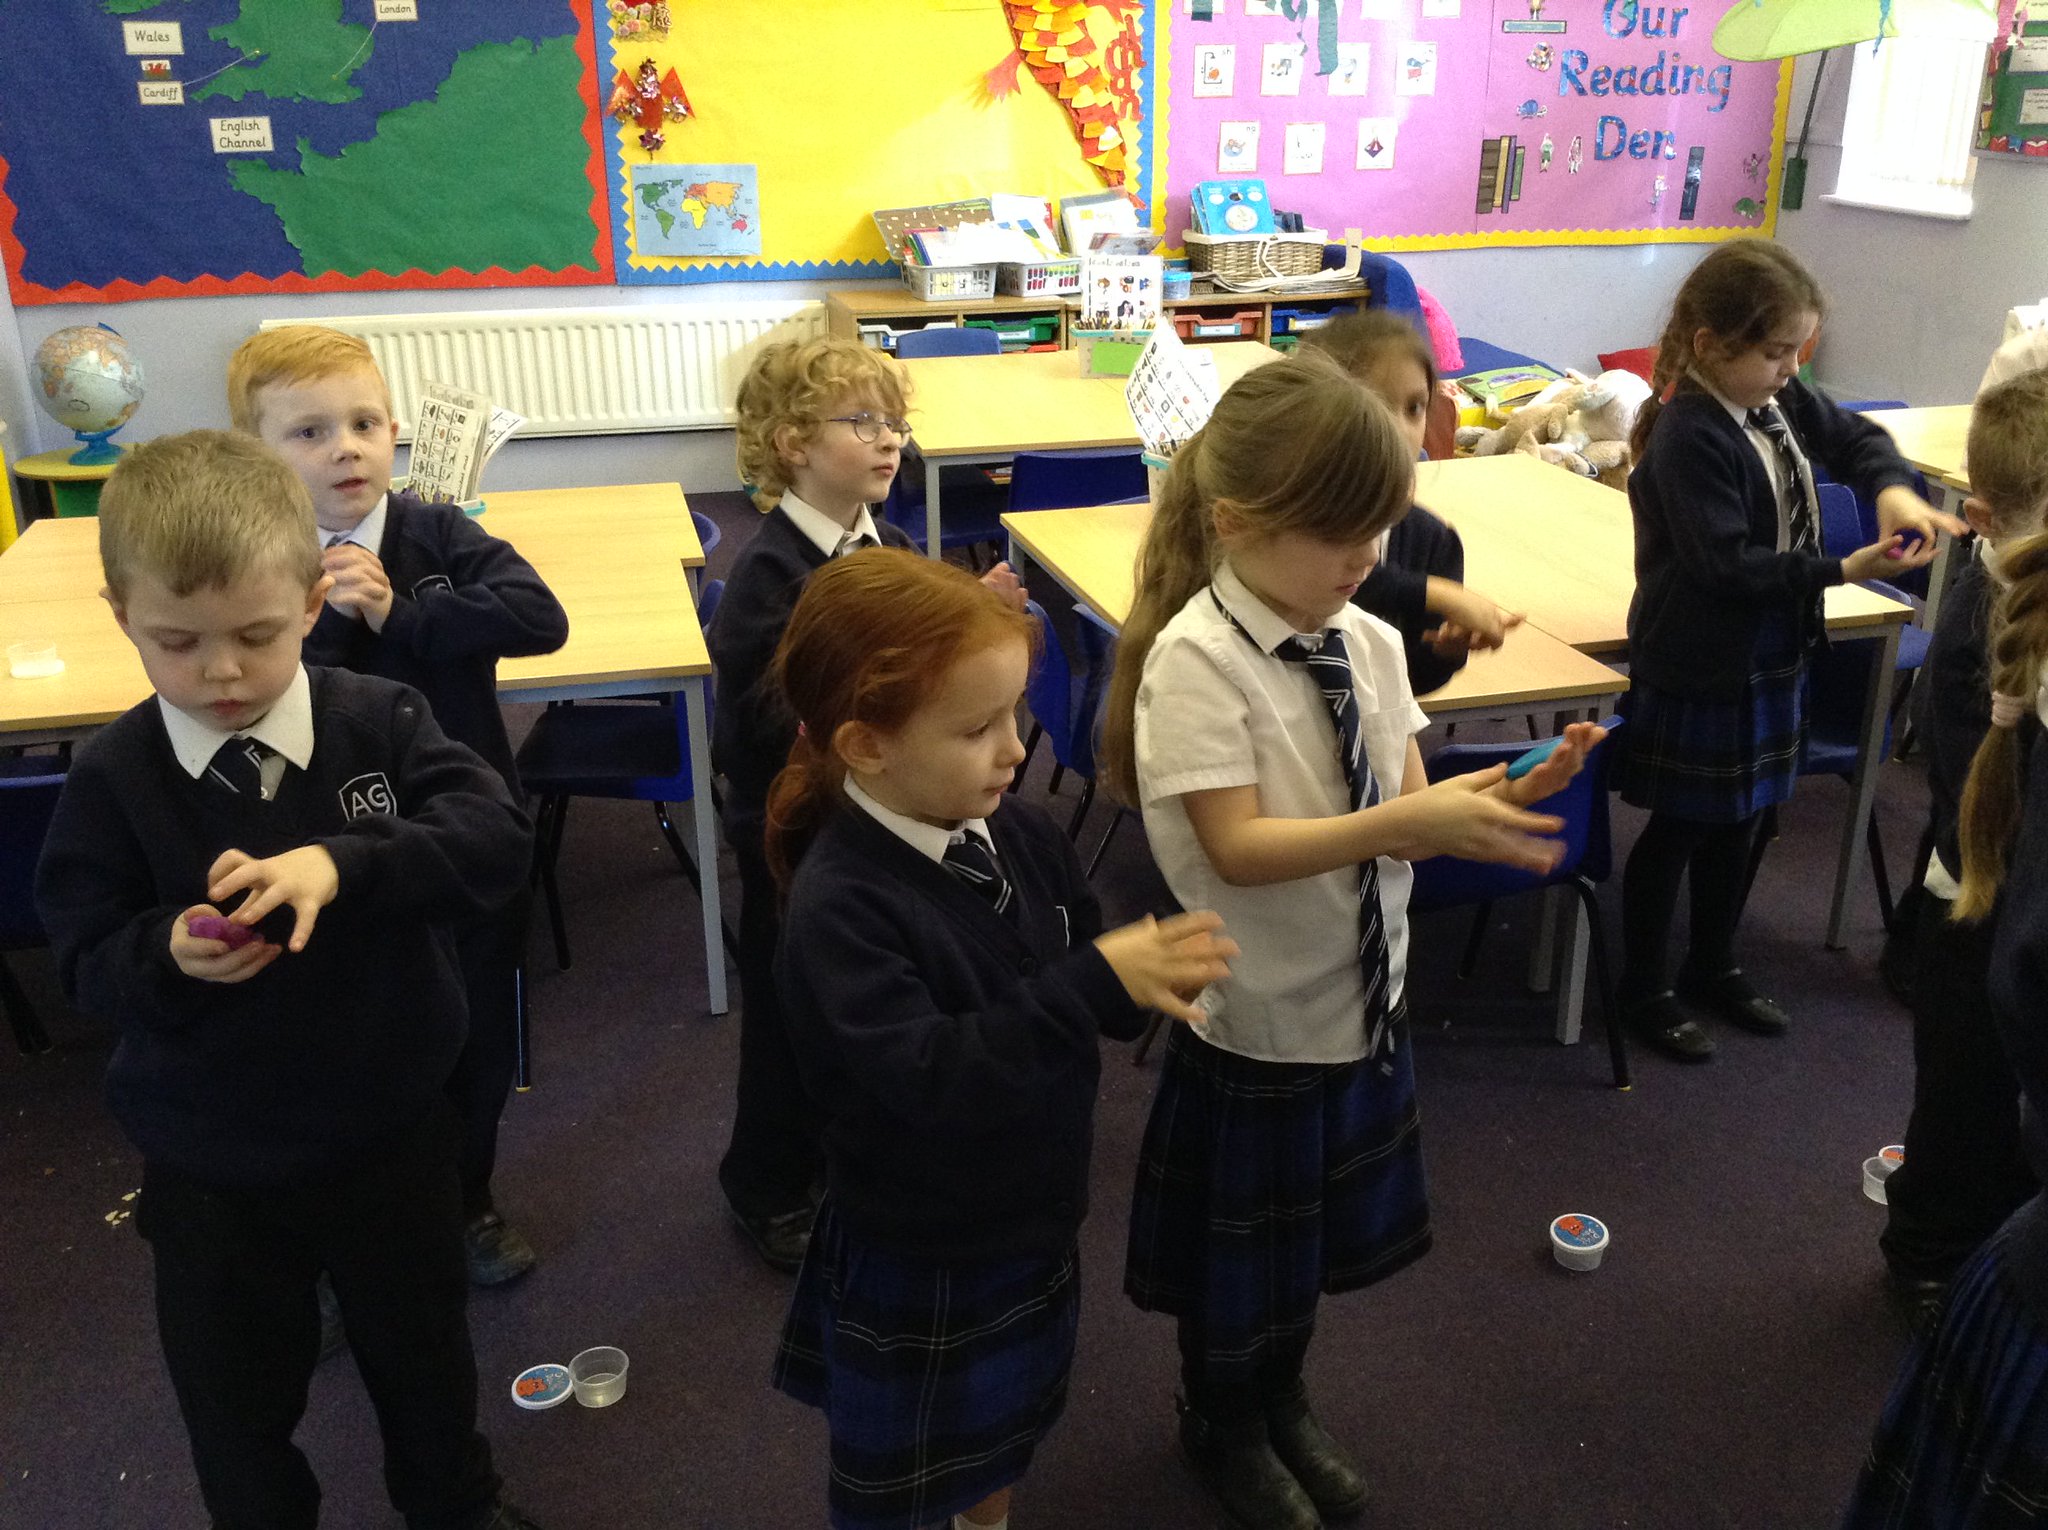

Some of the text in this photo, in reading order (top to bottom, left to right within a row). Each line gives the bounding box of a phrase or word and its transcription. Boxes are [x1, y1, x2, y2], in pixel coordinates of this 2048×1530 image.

[379, 3, 412, 14] London
[1603, 0, 1689, 38] Our
[134, 29, 170, 42] Wales
[1558, 49, 1733, 113] Reading
[143, 86, 178, 101] Cardiff
[220, 119, 260, 137] English
[219, 136, 266, 149] Channel
[1594, 115, 1678, 162] Den
[352, 783, 392, 818] AG
